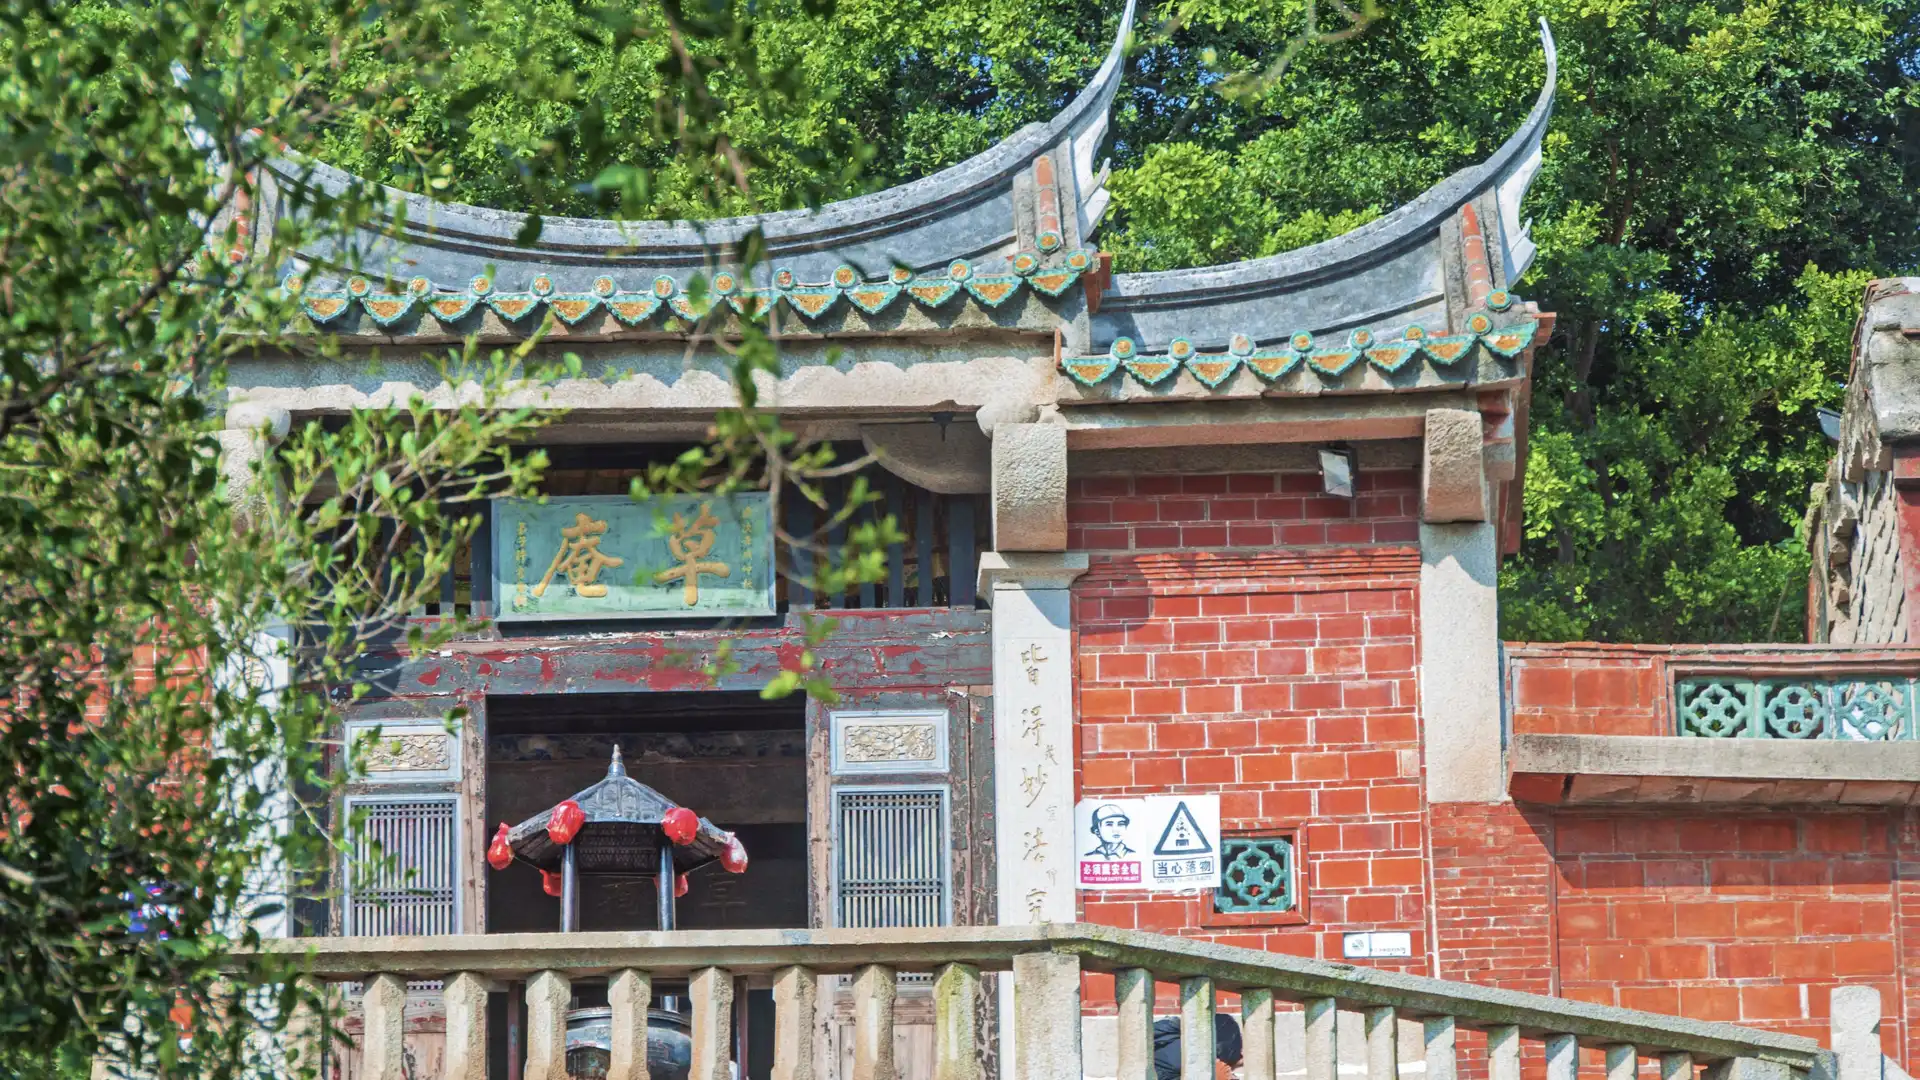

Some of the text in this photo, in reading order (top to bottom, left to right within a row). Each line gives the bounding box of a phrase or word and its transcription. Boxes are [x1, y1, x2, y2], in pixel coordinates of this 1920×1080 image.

[531, 502, 731, 607] 草庵
[1157, 860, 1211, 876] 当心落物
